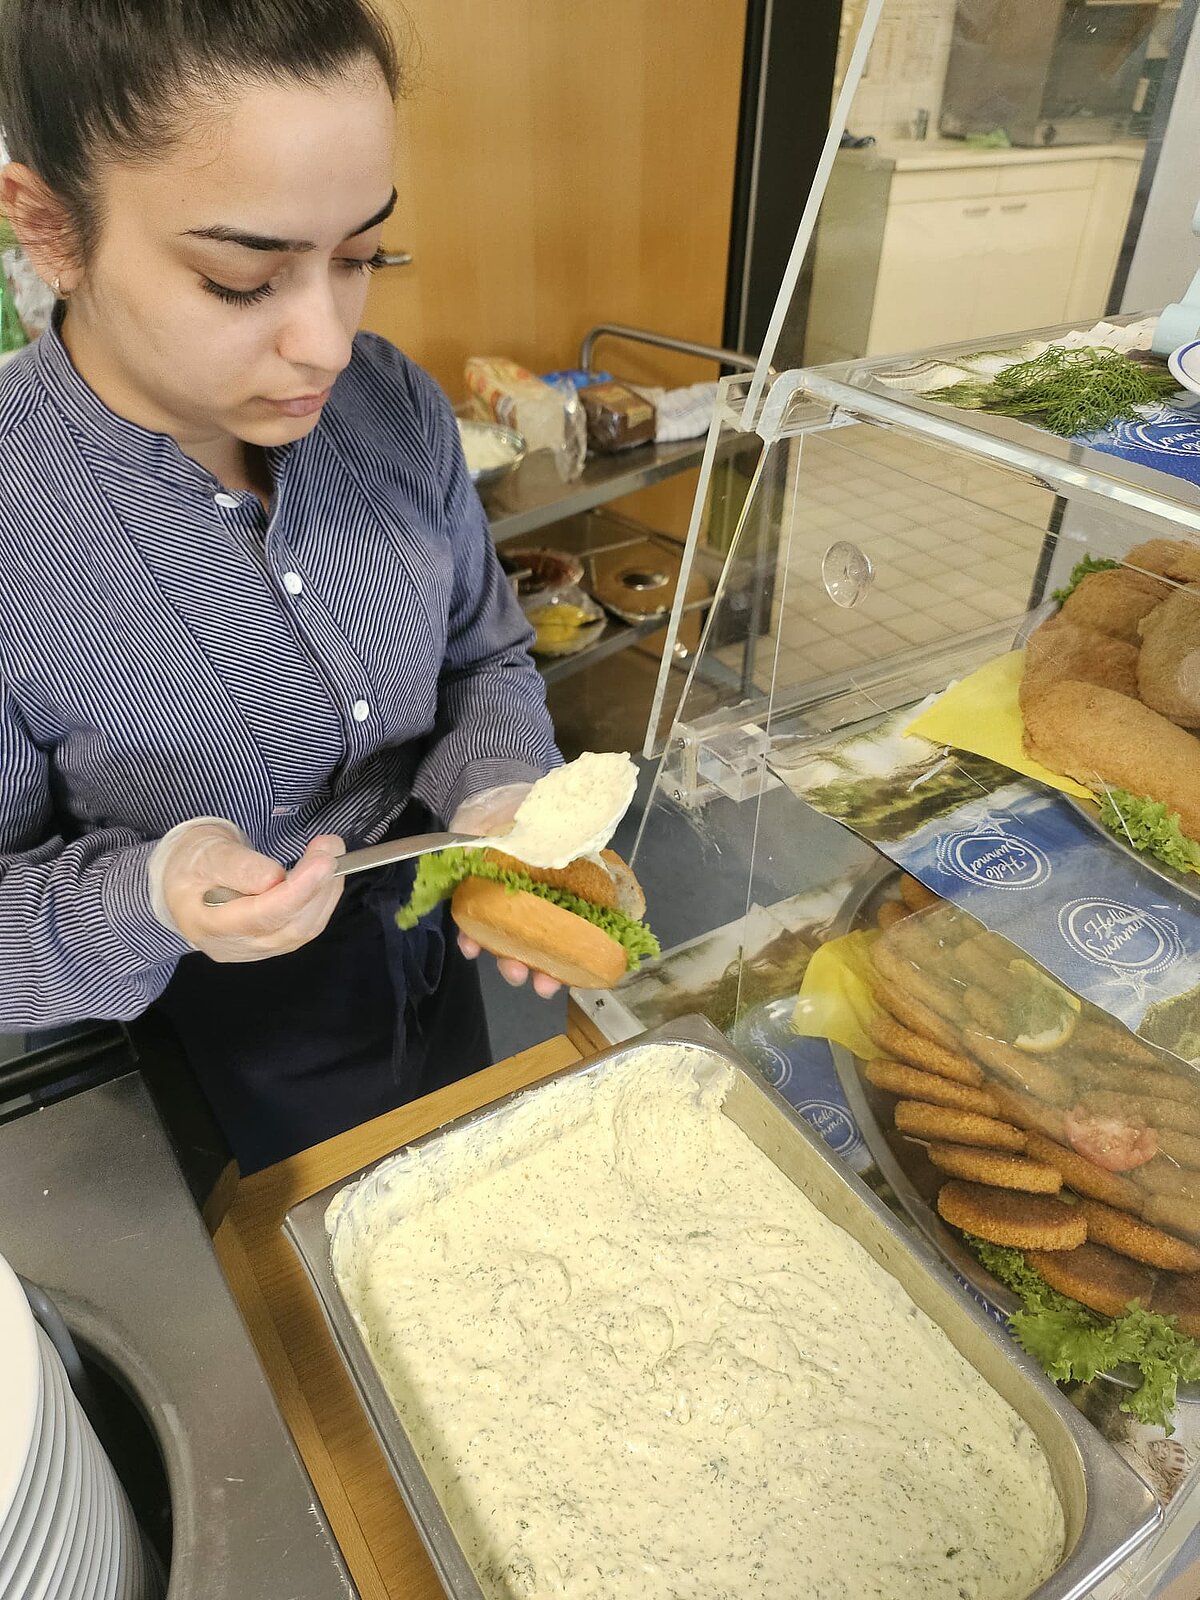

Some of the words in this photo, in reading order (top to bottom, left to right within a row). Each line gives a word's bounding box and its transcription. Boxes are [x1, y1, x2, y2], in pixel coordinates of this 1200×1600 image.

[971, 837, 1027, 876] Summer
[985, 854, 1027, 880] Hello
[1084, 908, 1126, 940] Hello
[1085, 919, 1145, 960] Summer
